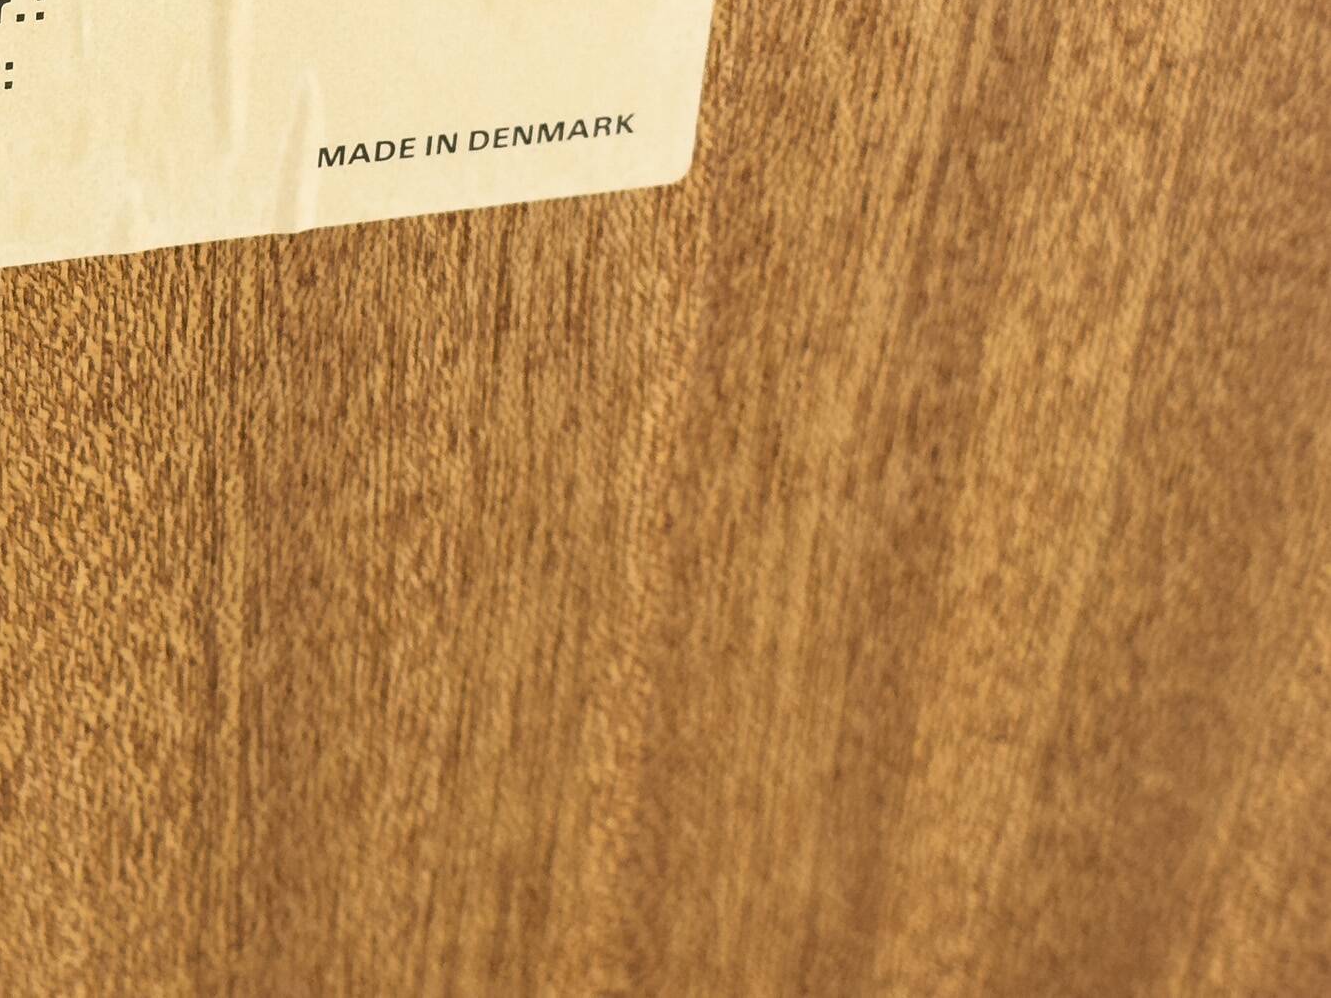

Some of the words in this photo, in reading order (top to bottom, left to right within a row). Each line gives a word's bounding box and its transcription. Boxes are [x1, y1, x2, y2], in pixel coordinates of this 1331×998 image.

[317, 137, 416, 168] MADE
[425, 132, 458, 156] IN
[468, 114, 634, 151] DENMARK
